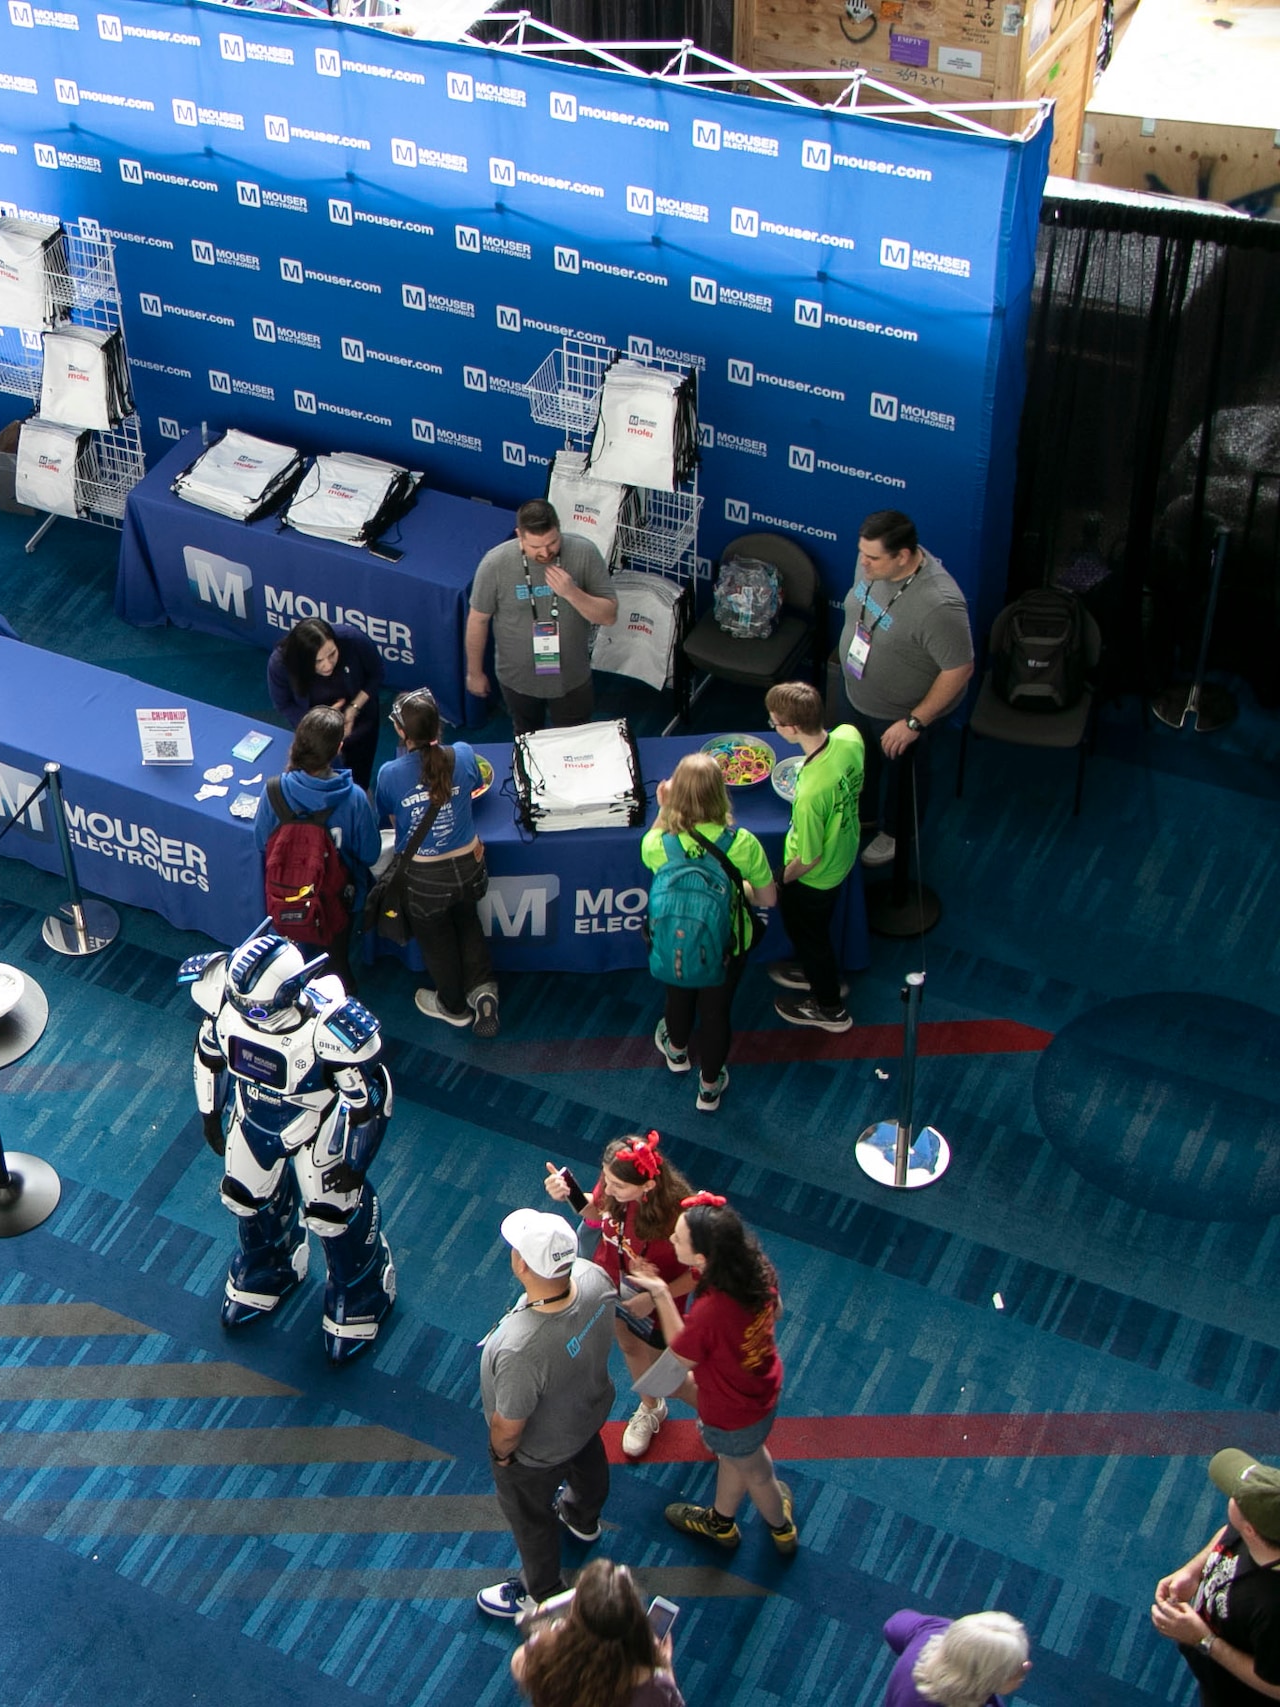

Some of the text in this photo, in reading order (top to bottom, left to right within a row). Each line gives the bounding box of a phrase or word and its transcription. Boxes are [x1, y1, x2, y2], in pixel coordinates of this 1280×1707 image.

[34, 9, 78, 24] MOUSER
[123, 26, 200, 46] mouser.com
[897, 35, 922, 46] EMPTY
[246, 43, 293, 59] MOUSER
[342, 61, 425, 84] mouser.com
[80, 90, 154, 111] mouser.com
[475, 82, 526, 102] MOUSER
[198, 108, 243, 124] MOUSER
[579, 106, 669, 131] mouser.com
[290, 127, 370, 150] mouser.com
[724, 130, 779, 151] MOUSER
[59, 152, 100, 167] MOUSER
[418, 148, 467, 167] MOUSER
[834, 154, 932, 181] mouser.com
[144, 171, 218, 191] mouser.com
[517, 171, 604, 197] mouser.com
[262, 191, 307, 207] MOUSER
[263, 199, 307, 212] ELECTRONICS
[656, 197, 709, 217] MOUSER
[355, 212, 434, 235] mouser.com
[103, 229, 173, 250] mouser.com
[483, 235, 531, 254] MOUSER
[761, 221, 854, 249] mouser.com
[216, 249, 259, 265] MOUSER
[483, 243, 531, 259] ELECTRONICS
[913, 250, 970, 271] MOUSER
[217, 257, 260, 270] ELECTRONICS
[582, 260, 667, 286] mouser.com
[912, 260, 970, 277] ELECTRONICS
[305, 270, 381, 293] mouser.com
[428, 294, 474, 312] MOUSER
[720, 287, 772, 307] MOUSER
[720, 297, 771, 312] ELECTRONICS
[163, 305, 234, 326] mouser.com
[429, 303, 474, 317] ELECTRONICS
[277, 327, 320, 344] MOUSER
[523, 318, 605, 345] mouser.com
[825, 314, 918, 341] mouser.com
[278, 335, 321, 349] ELECTRONICS
[366, 350, 442, 374] mouser.com
[657, 347, 705, 365] MOUSER
[68, 372, 90, 383] molex
[232, 379, 274, 396] MOUSER
[490, 376, 535, 394] MOUSE
[757, 373, 845, 400] mouser.com
[233, 387, 274, 400] ELECTRONICS
[318, 402, 391, 426] mouser.com
[901, 404, 955, 425] MOUSER
[901, 414, 954, 431] ELECTRONICS
[437, 429, 481, 447] MOUSER
[438, 437, 481, 451] ELECTRONICS
[717, 432, 766, 451] MOUSER
[718, 441, 766, 457] ELECTRONICS
[818, 460, 905, 488] mouser.com
[753, 512, 837, 540] mouser.com
[195, 559, 413, 649] M MOUSER
[64, 800, 208, 876] MOUSER
[69, 829, 210, 893] ELECTRONICS
[477, 887, 547, 937] M
